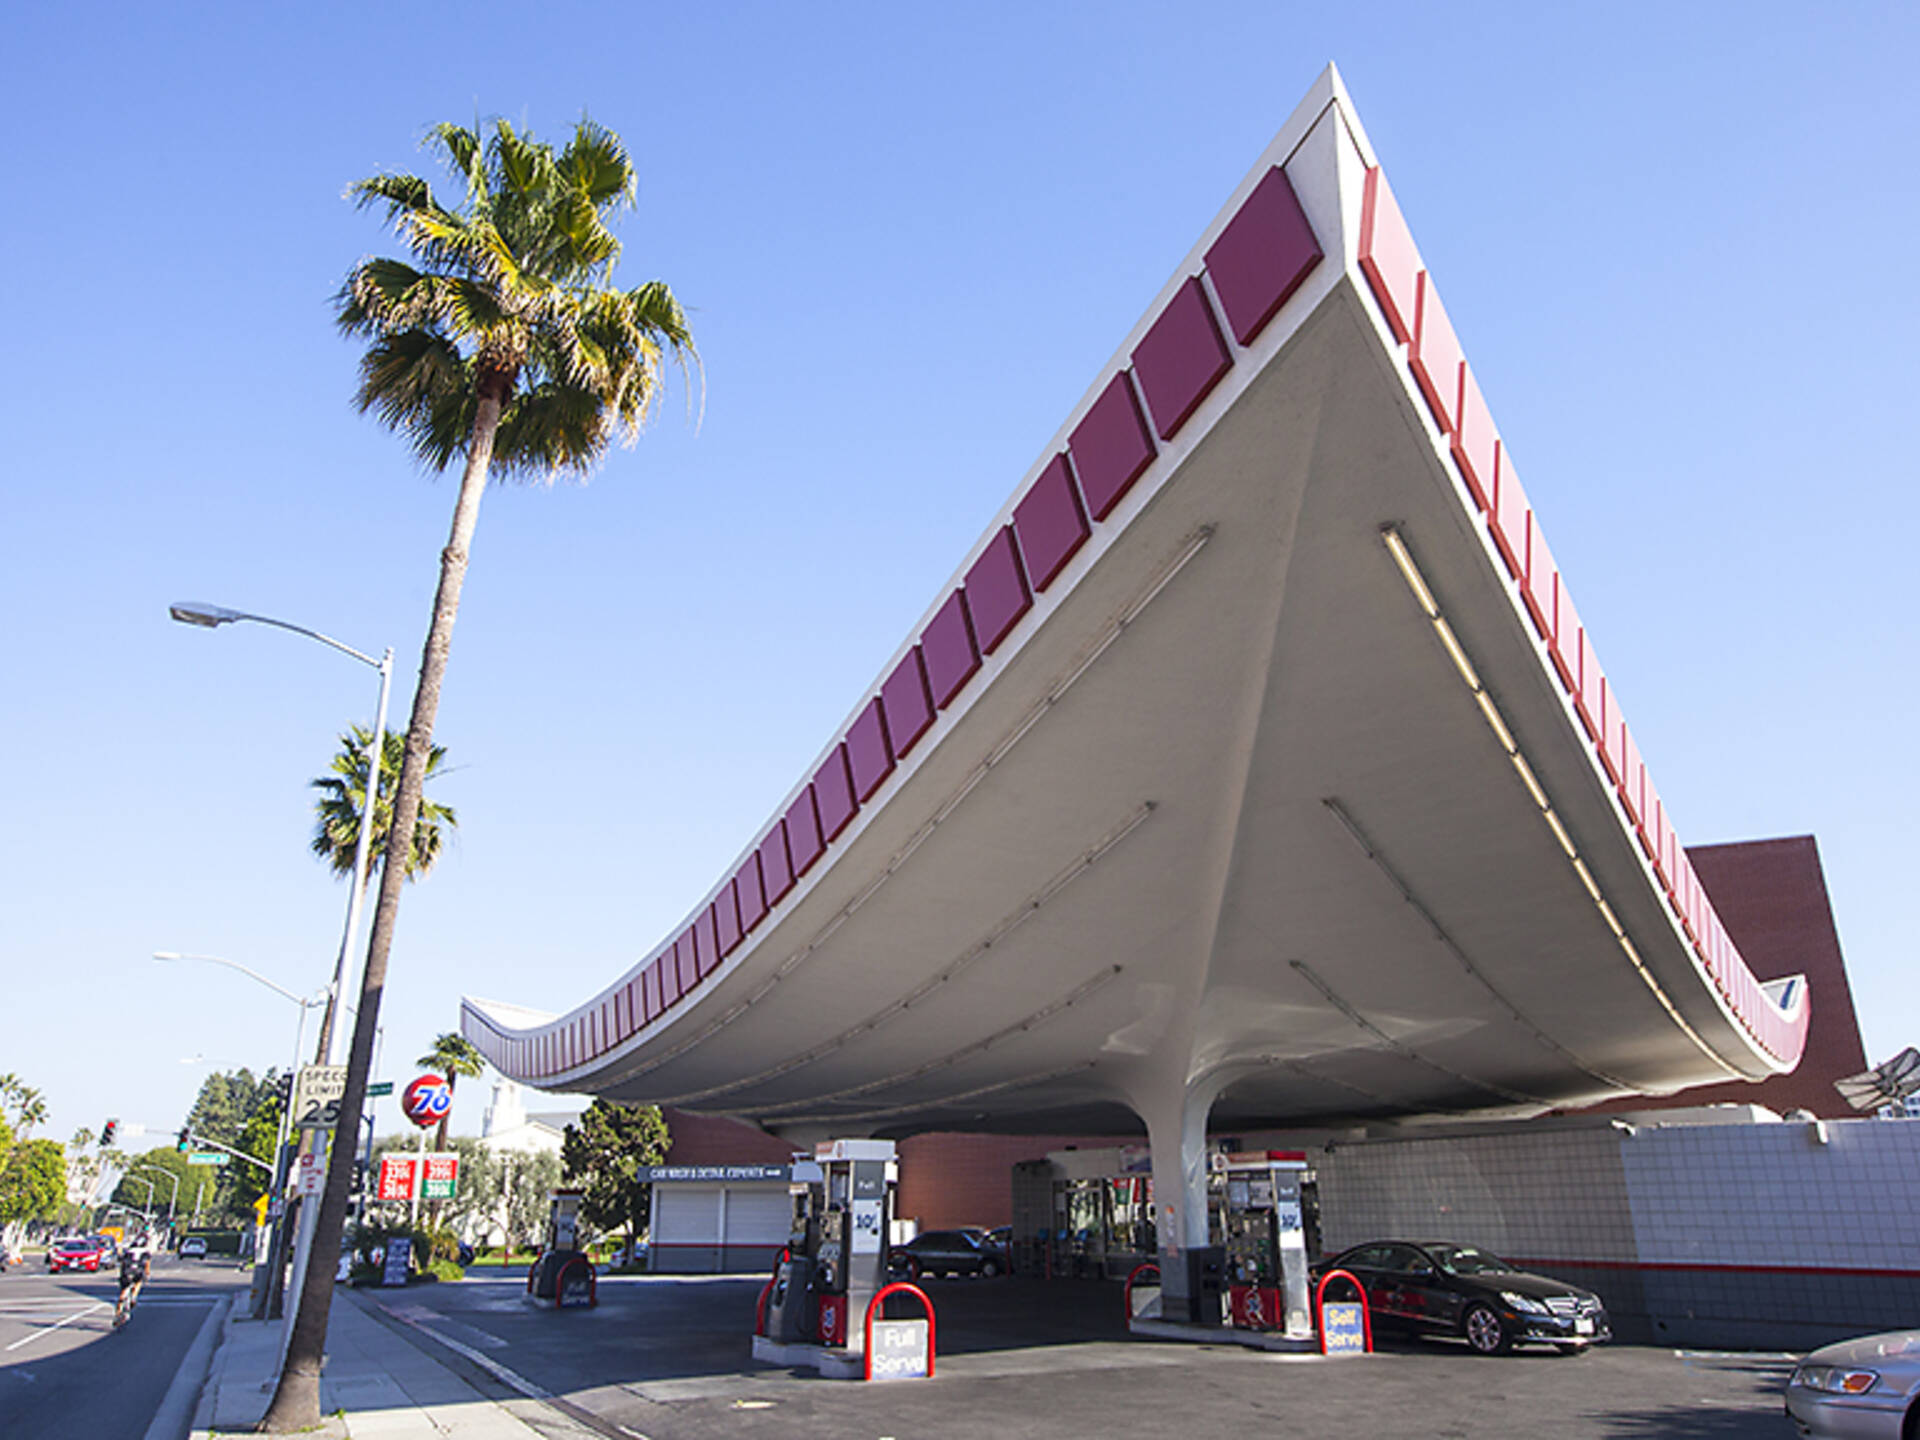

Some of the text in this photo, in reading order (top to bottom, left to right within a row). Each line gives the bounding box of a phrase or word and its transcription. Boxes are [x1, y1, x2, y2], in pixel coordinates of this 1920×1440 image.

[306, 1085, 342, 1096] LIMIT
[411, 1087, 450, 1114] 76
[302, 1099, 341, 1122] 25
[884, 1328, 916, 1347] Full
[1327, 1331, 1363, 1347] Serve
[876, 1354, 925, 1372] Serve
